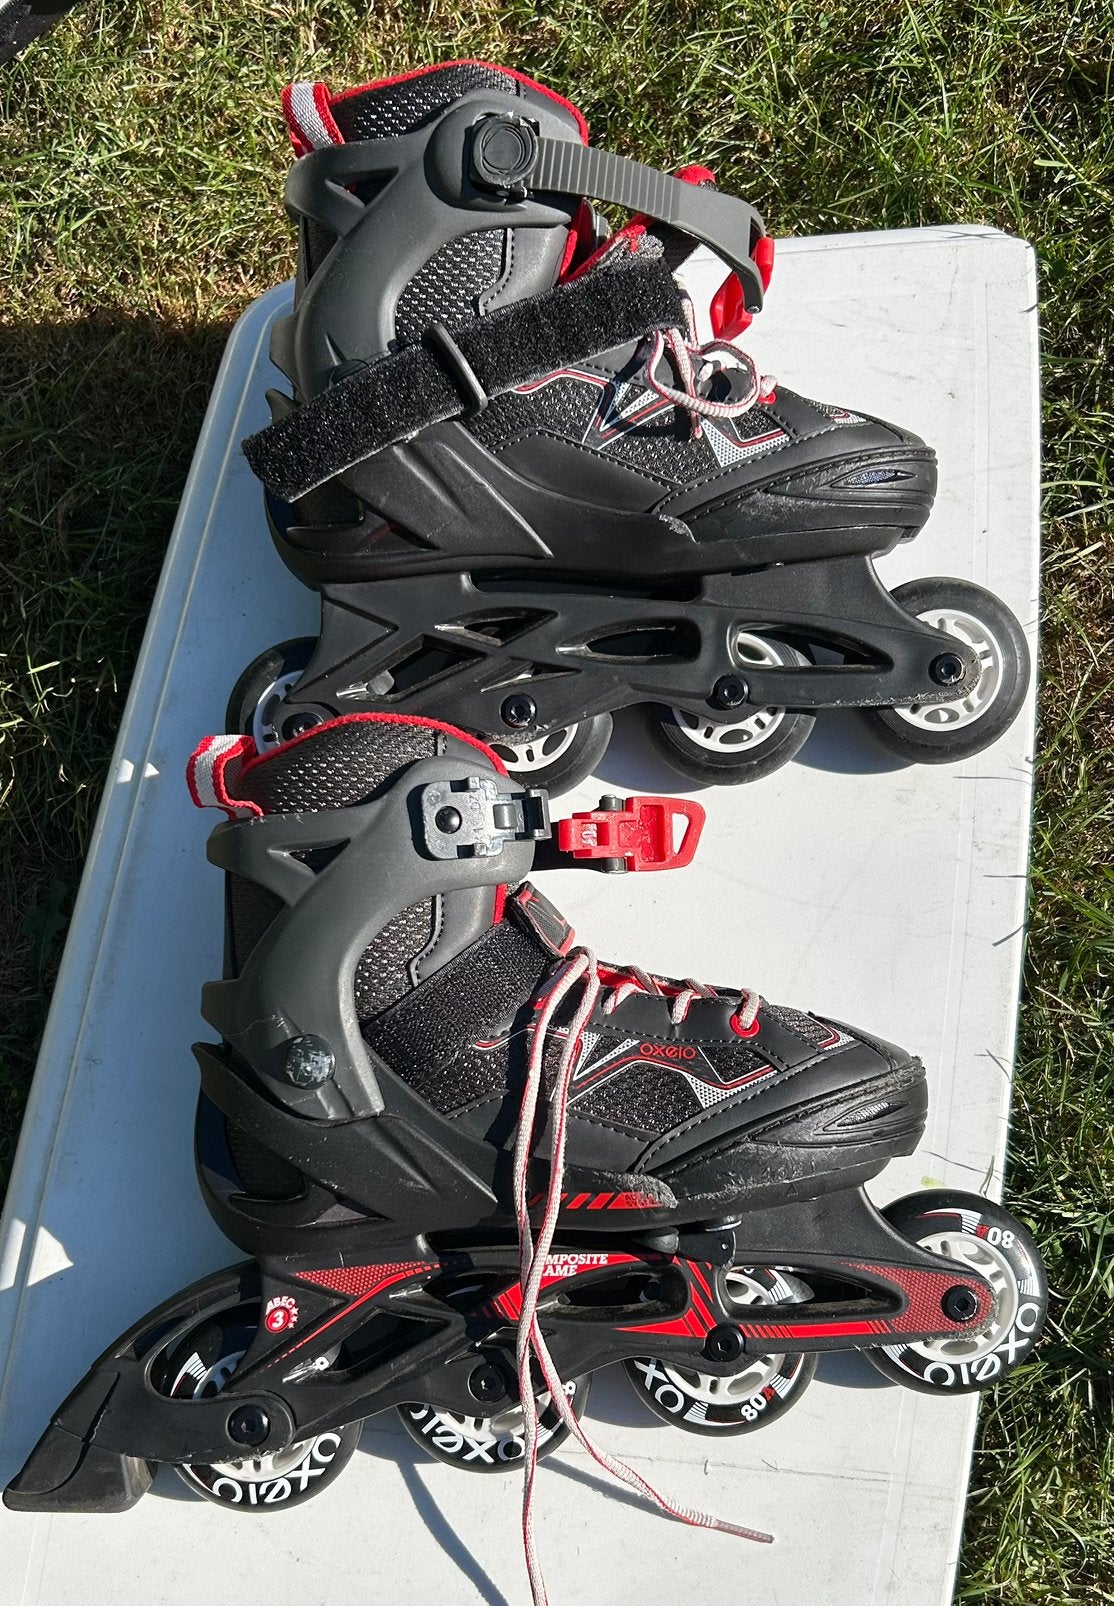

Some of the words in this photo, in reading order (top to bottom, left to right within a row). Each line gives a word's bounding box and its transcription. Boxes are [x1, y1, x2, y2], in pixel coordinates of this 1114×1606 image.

[640, 1043, 697, 1060] oxelo
[976, 1224, 1015, 1249] 80A
[545, 1253, 609, 1266] MPOSITE
[543, 1265, 578, 1277] AME
[266, 1295, 296, 1316] ABEC
[271, 1311, 285, 1328] 3
[740, 1385, 777, 1422] 80A
